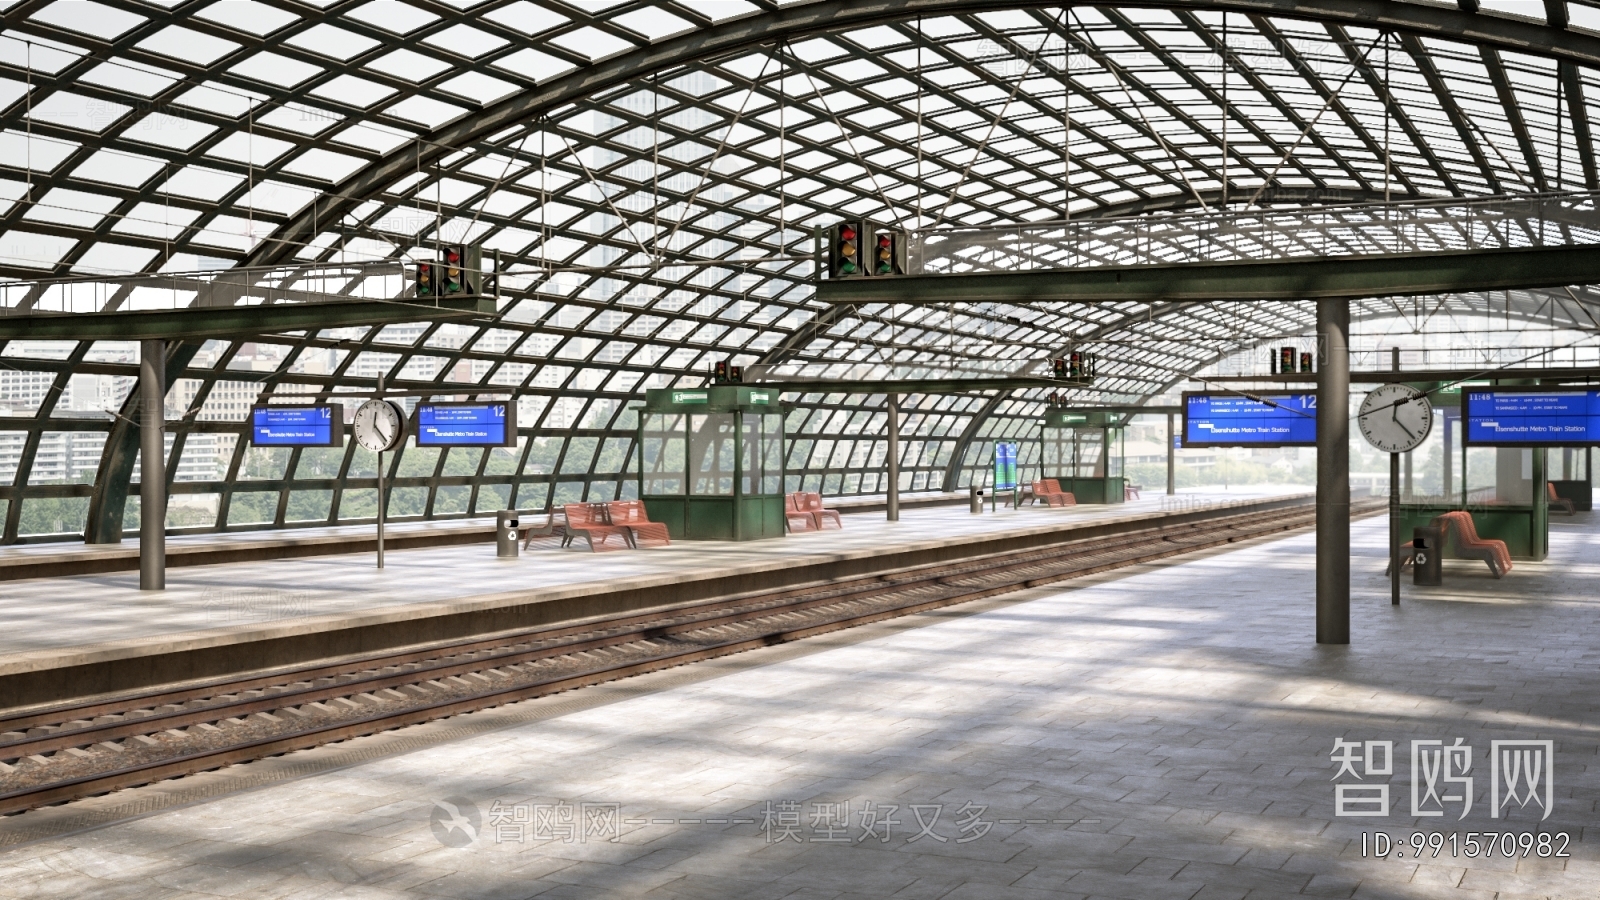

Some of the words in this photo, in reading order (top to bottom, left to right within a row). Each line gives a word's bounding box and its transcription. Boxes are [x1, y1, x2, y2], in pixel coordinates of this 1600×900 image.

[1298, 394, 1317, 409] 12
[1469, 393, 1491, 401] 11:48
[320, 407, 332, 419] 12
[493, 405, 505, 417] 12
